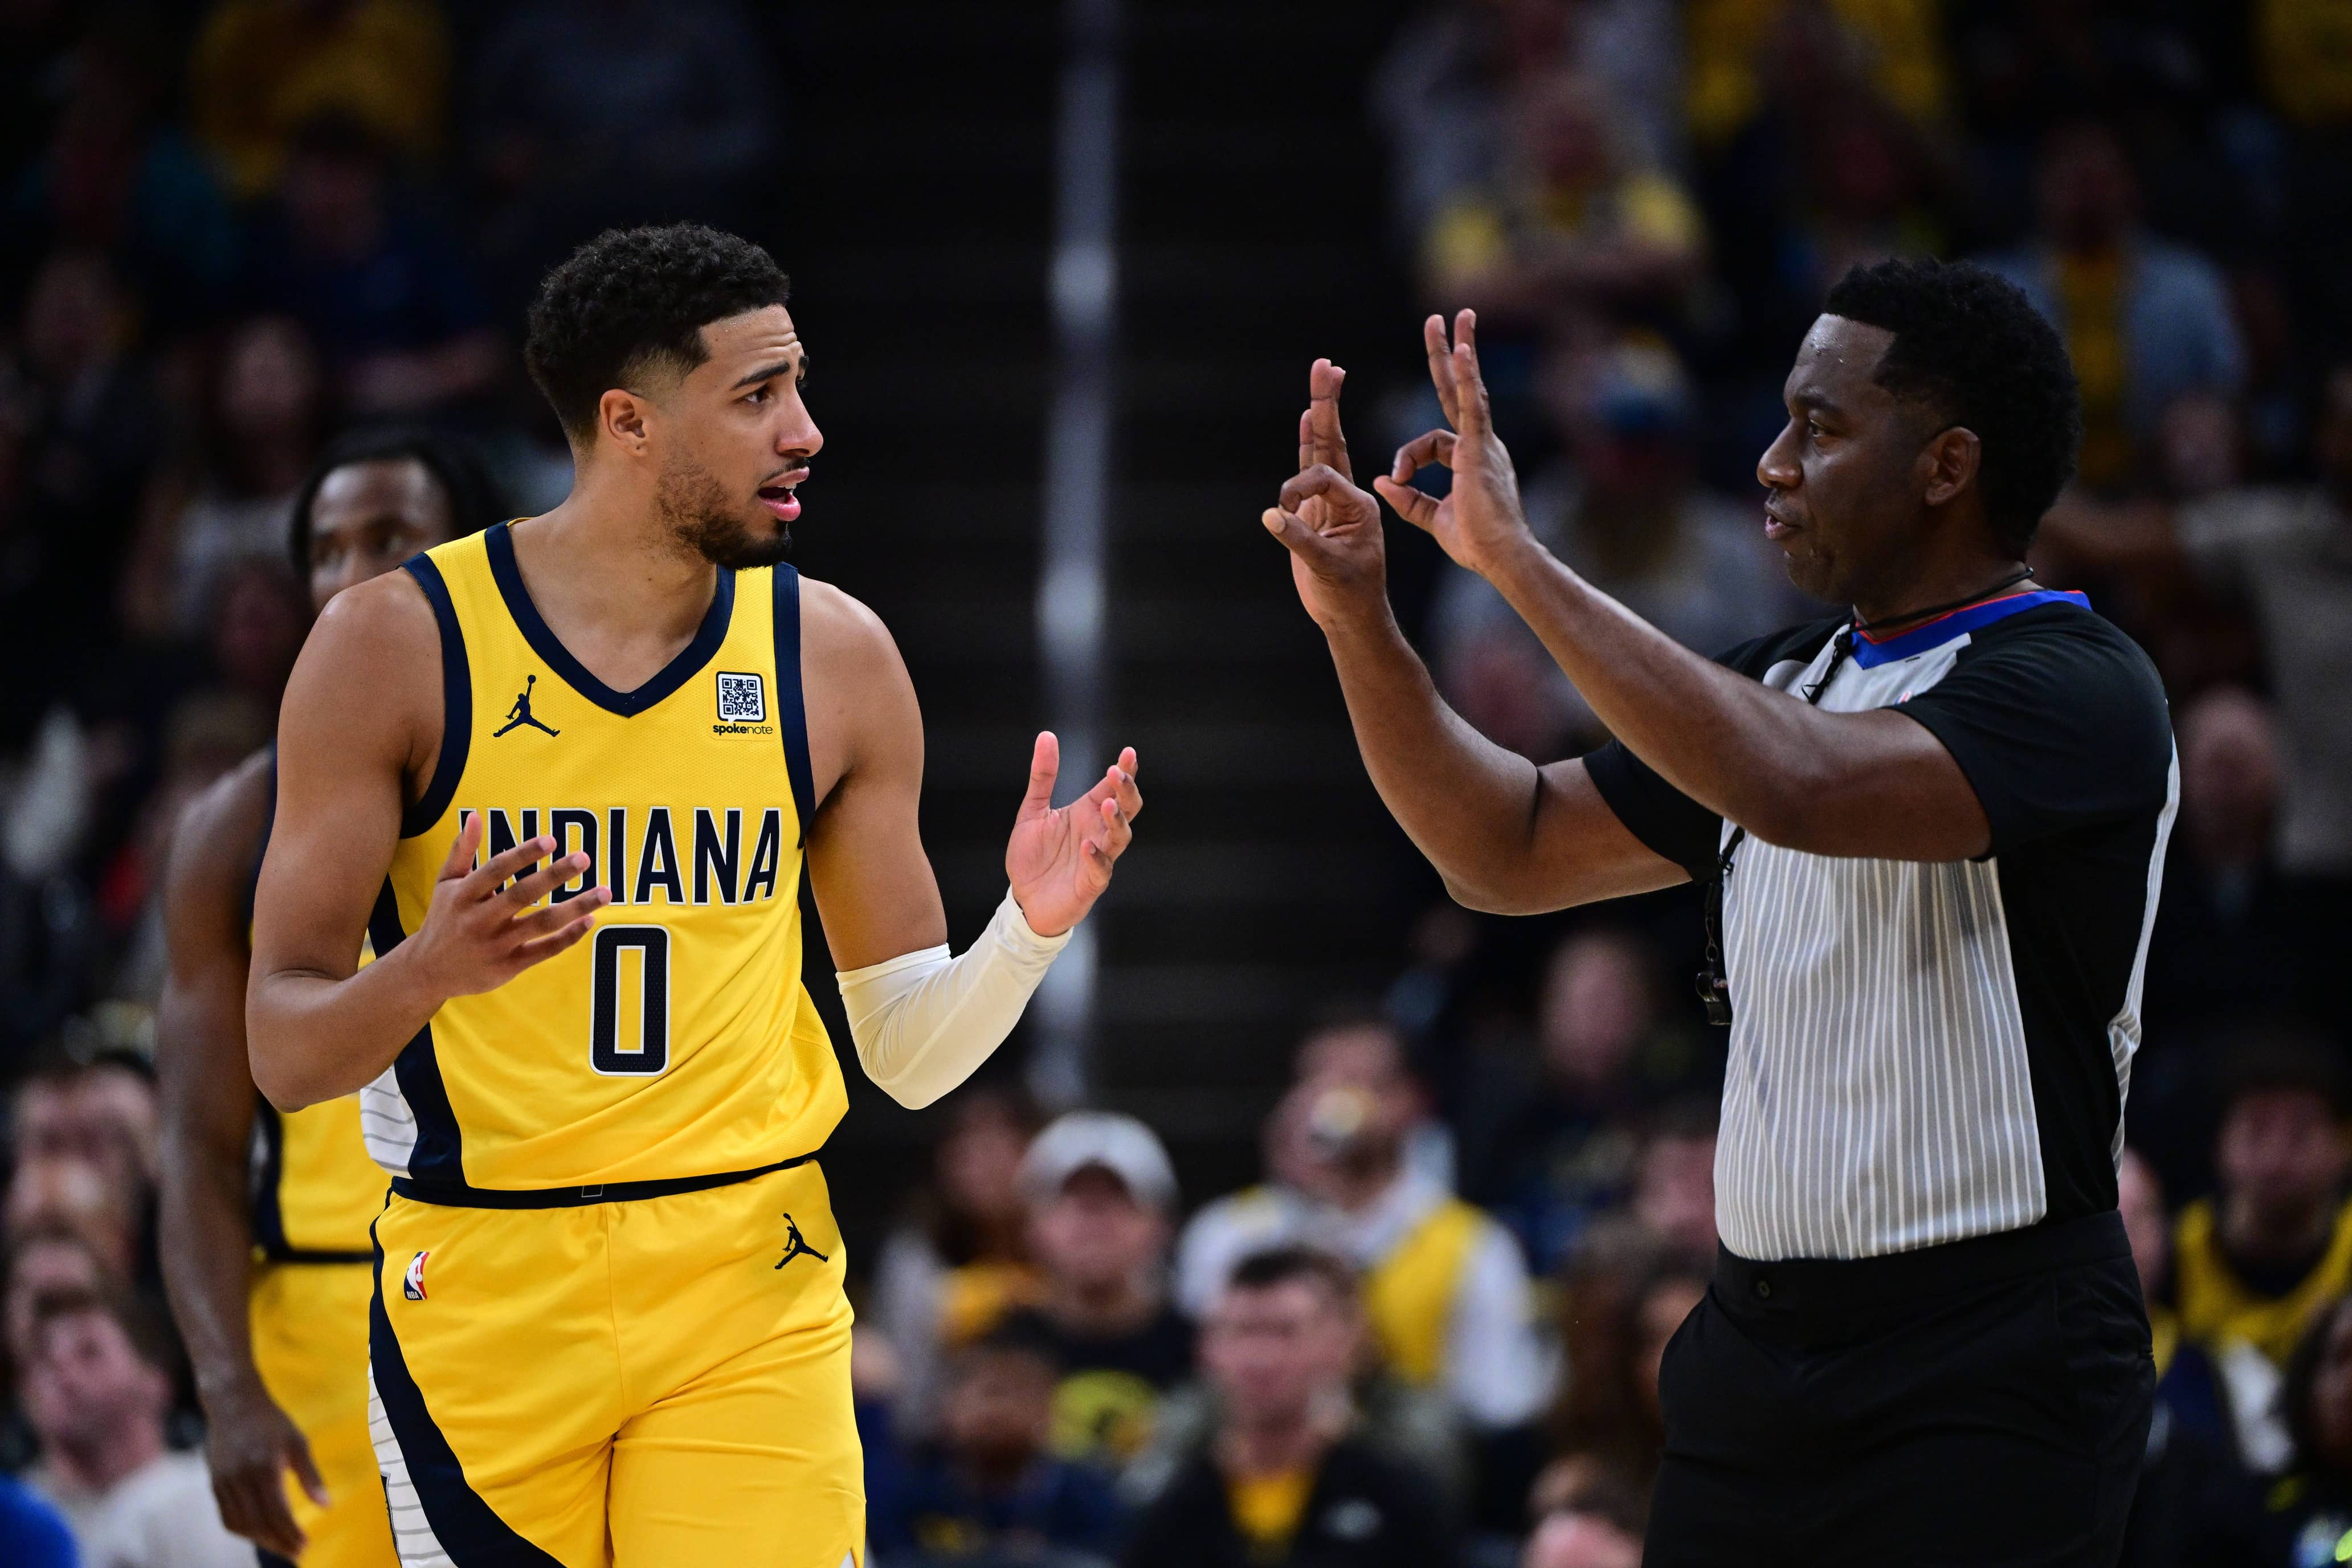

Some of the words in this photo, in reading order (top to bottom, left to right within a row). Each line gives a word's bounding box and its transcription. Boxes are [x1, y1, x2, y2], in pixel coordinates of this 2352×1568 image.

[713, 723, 773, 736] spokenote
[458, 806, 781, 906] NDIANA
[589, 924, 670, 1077] 0
[406, 1291, 420, 1299] NBA
